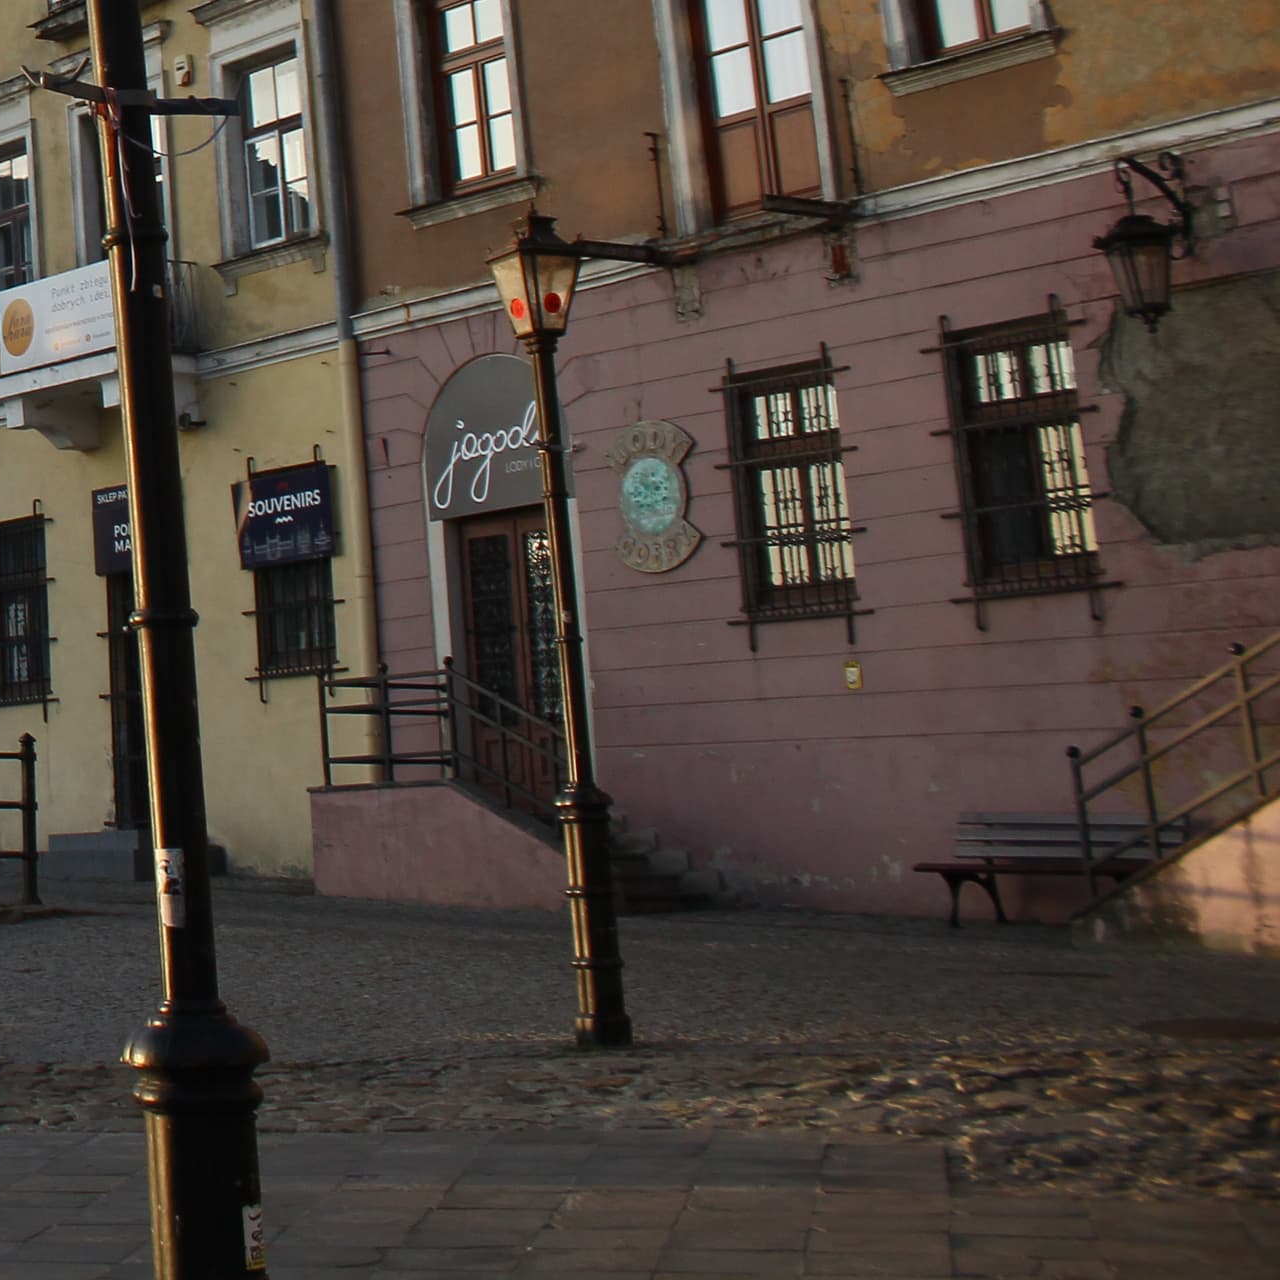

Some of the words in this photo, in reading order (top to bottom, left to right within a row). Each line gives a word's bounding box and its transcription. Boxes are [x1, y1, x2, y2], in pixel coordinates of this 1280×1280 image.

[505, 459, 529, 473] LODY
[96, 491, 118, 505] SKLEP
[247, 488, 321, 518] SOUVENIRS
